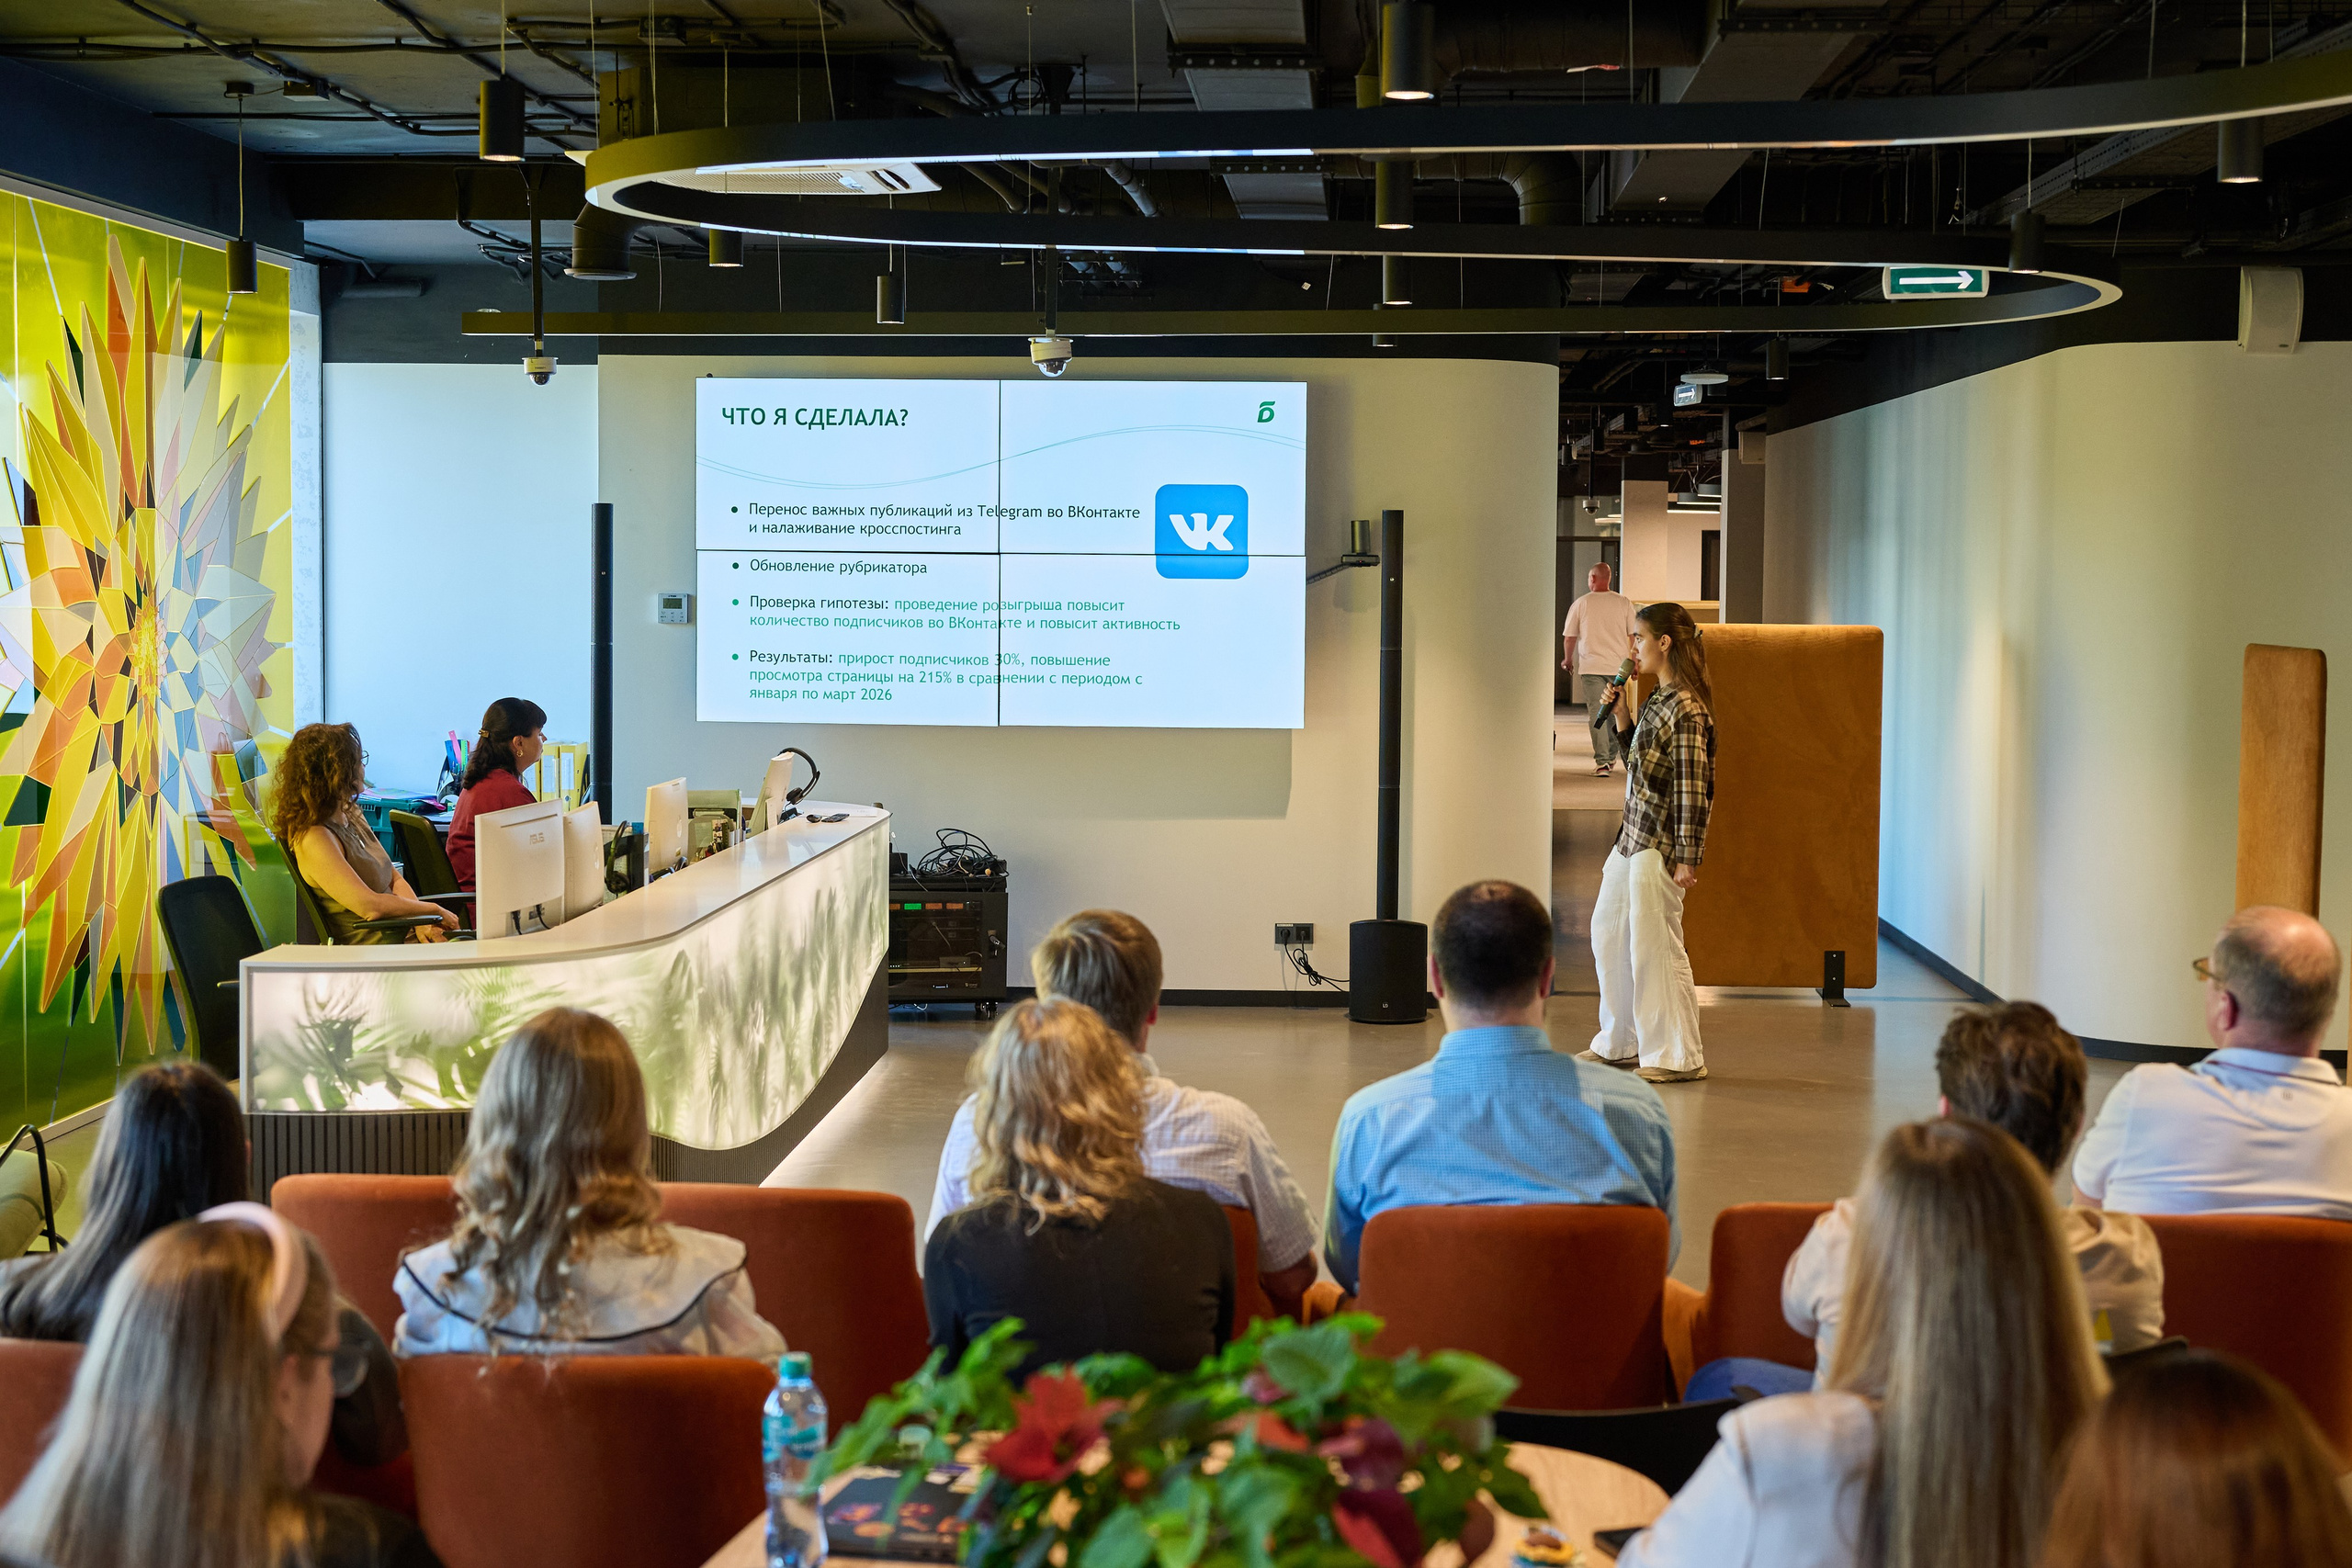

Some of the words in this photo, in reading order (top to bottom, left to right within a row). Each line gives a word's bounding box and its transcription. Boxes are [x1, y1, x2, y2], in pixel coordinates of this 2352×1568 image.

[721, 407, 766, 426] ЧТО
[773, 407, 787, 426] Я
[794, 407, 909, 431] СДЕЛАЛА?
[749, 502, 808, 519] Перенос
[812, 505, 865, 516] важных
[869, 502, 953, 520] публикаций
[956, 507, 973, 517] из
[977, 504, 1043, 521] Telegram
[1046, 508, 1064, 518] во
[1068, 504, 1141, 519] ВКонтакте
[749, 524, 758, 534] и
[762, 524, 856, 535] налаживание
[859, 525, 962, 538] кросспостинга
[750, 558, 835, 573] Обновление
[839, 559, 928, 577] рубрикатора
[750, 594, 816, 612] Проверка
[820, 599, 889, 610] гипотезы:
[894, 600, 978, 614] проведение
[982, 601, 1063, 615] розыгрыша
[1067, 601, 1125, 612] повысит
[750, 615, 830, 627] количество
[833, 617, 924, 630] подписчиков
[928, 618, 944, 629] во
[948, 615, 1023, 630] ВКонтакте
[1026, 619, 1035, 629] и
[1039, 619, 1099, 630] повысит
[1102, 619, 1182, 631] активность
[750, 649, 833, 666] Результаты:
[838, 653, 895, 668] прирост
[899, 655, 989, 668] подписчиков
[994, 652, 1025, 668] 30%,
[1030, 656, 1112, 667] повышение
[749, 671, 823, 684] просмотра
[827, 671, 894, 685] страницы
[898, 672, 915, 683] на
[919, 670, 953, 684] 215%
[956, 673, 965, 684] в
[968, 673, 1045, 687] сравнении
[1048, 674, 1057, 684] с
[1061, 674, 1131, 688] периодом
[1135, 674, 1143, 685] с
[749, 688, 797, 703] января
[802, 689, 819, 700] по
[822, 690, 857, 704] март
[860, 687, 893, 701] 2026
